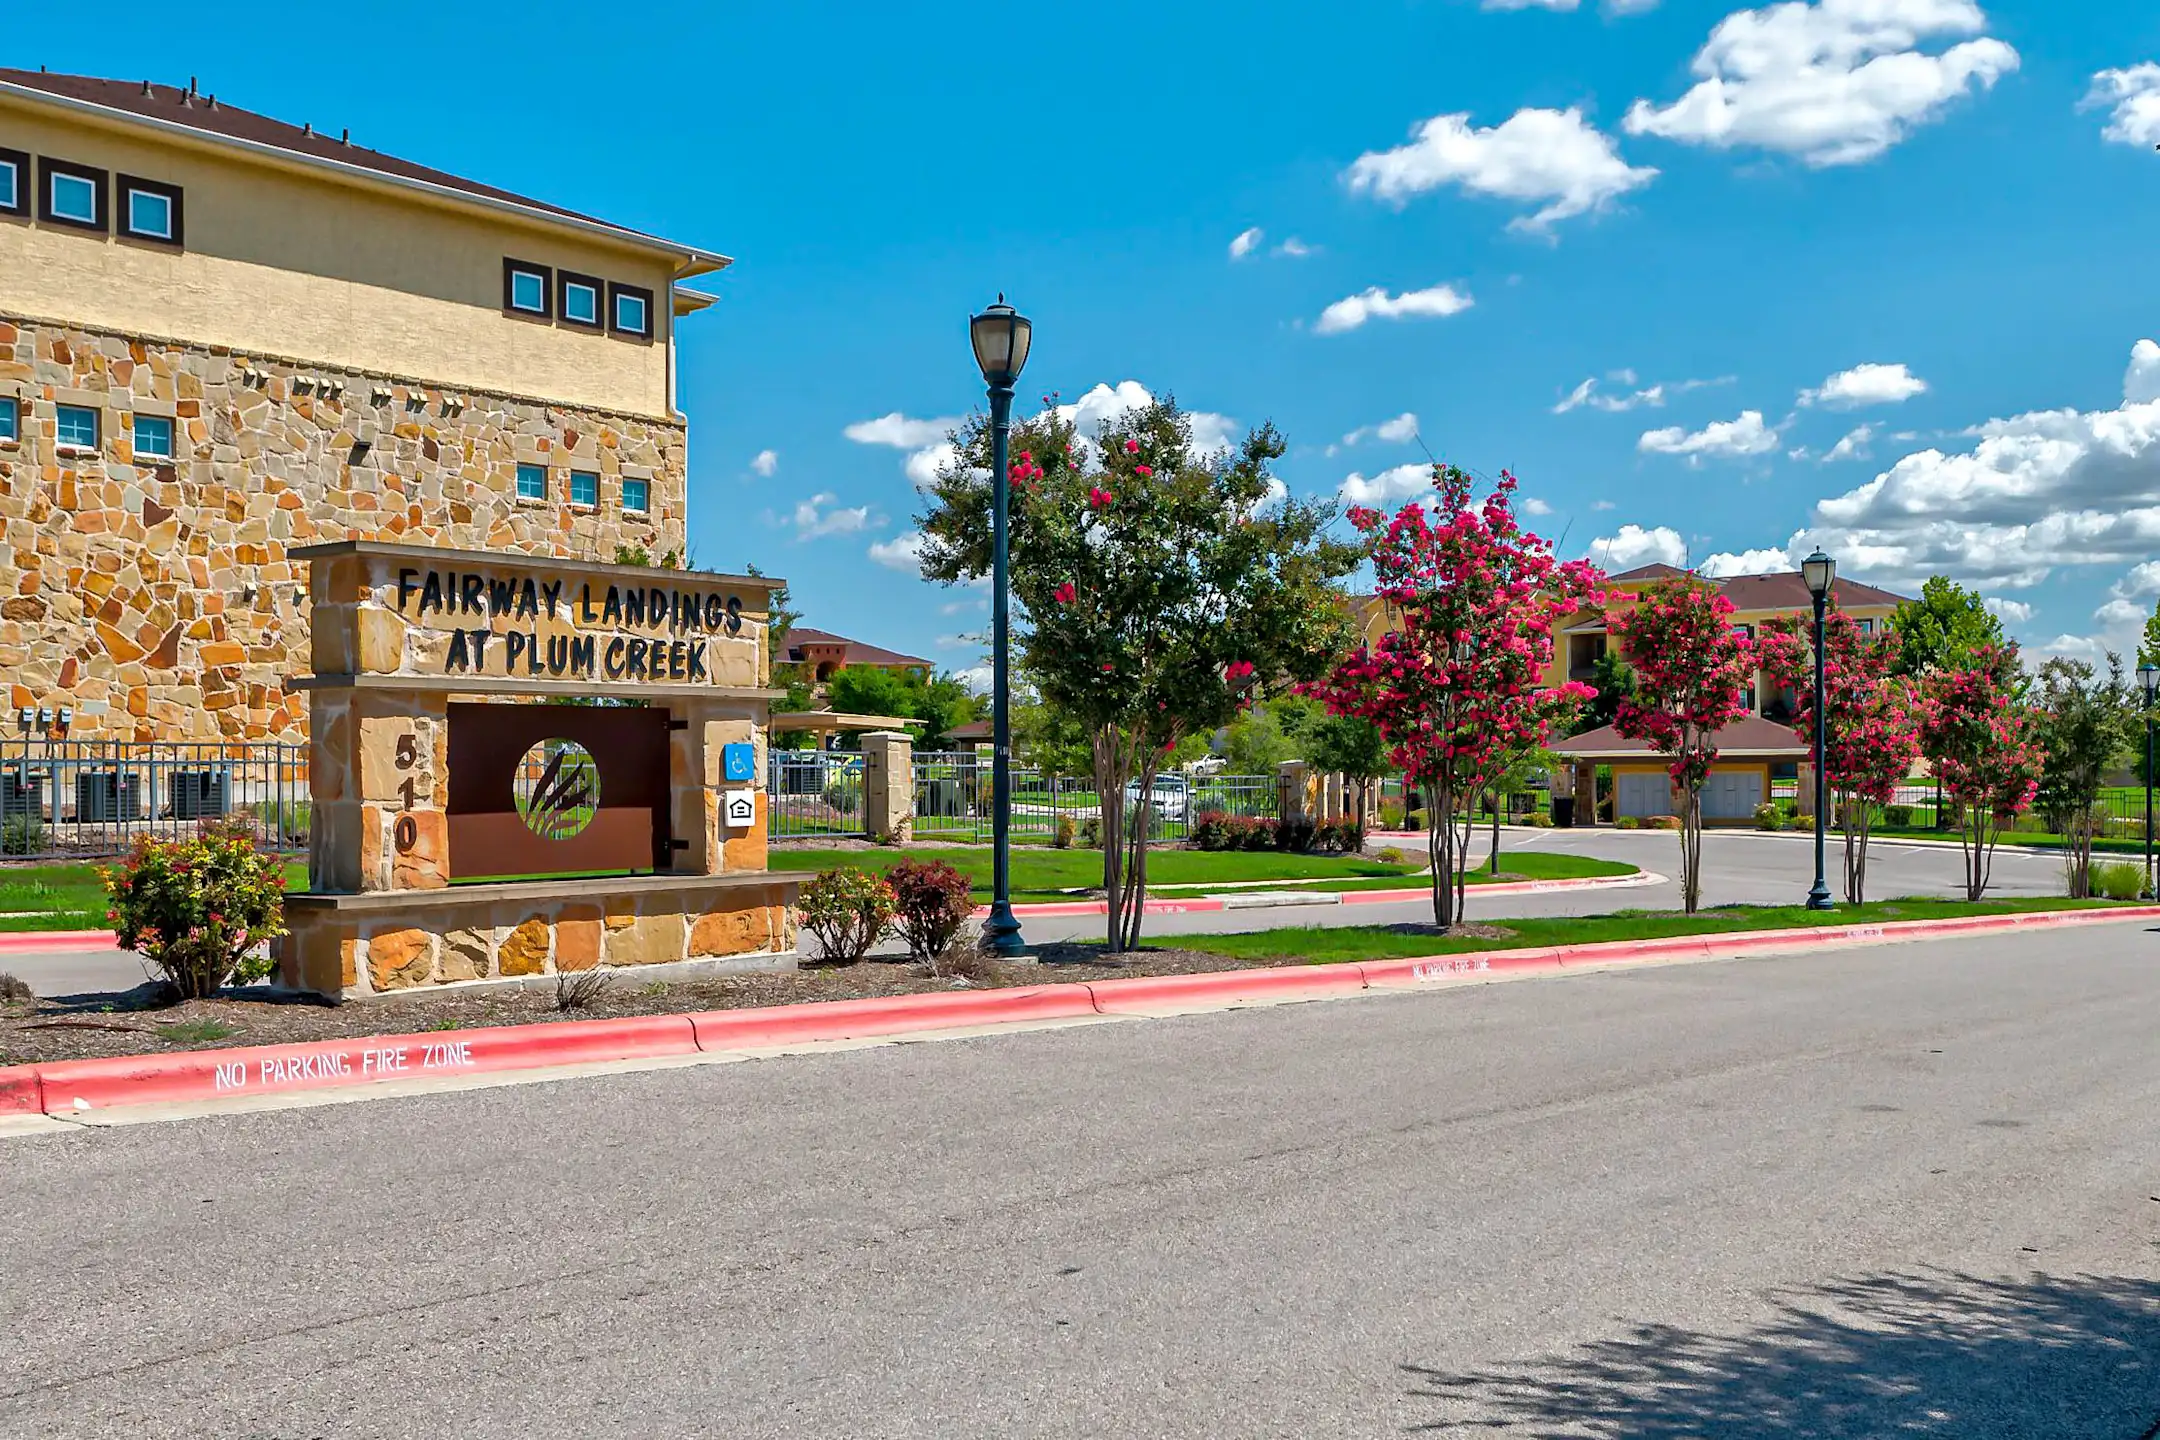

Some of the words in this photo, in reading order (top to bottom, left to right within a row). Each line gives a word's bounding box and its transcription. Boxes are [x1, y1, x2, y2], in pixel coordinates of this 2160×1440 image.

[398, 569, 562, 622] FAIRWAY
[581, 583, 742, 637] LANDINGS
[445, 628, 491, 675] AT
[506, 630, 595, 676] PLUM
[604, 637, 707, 682] CREEK
[395, 734, 417, 853] 510
[215, 1062, 246, 1091] NO
[261, 1052, 352, 1084] PARKING
[362, 1047, 409, 1075] FIRE
[421, 1041, 475, 1068] ZONE
